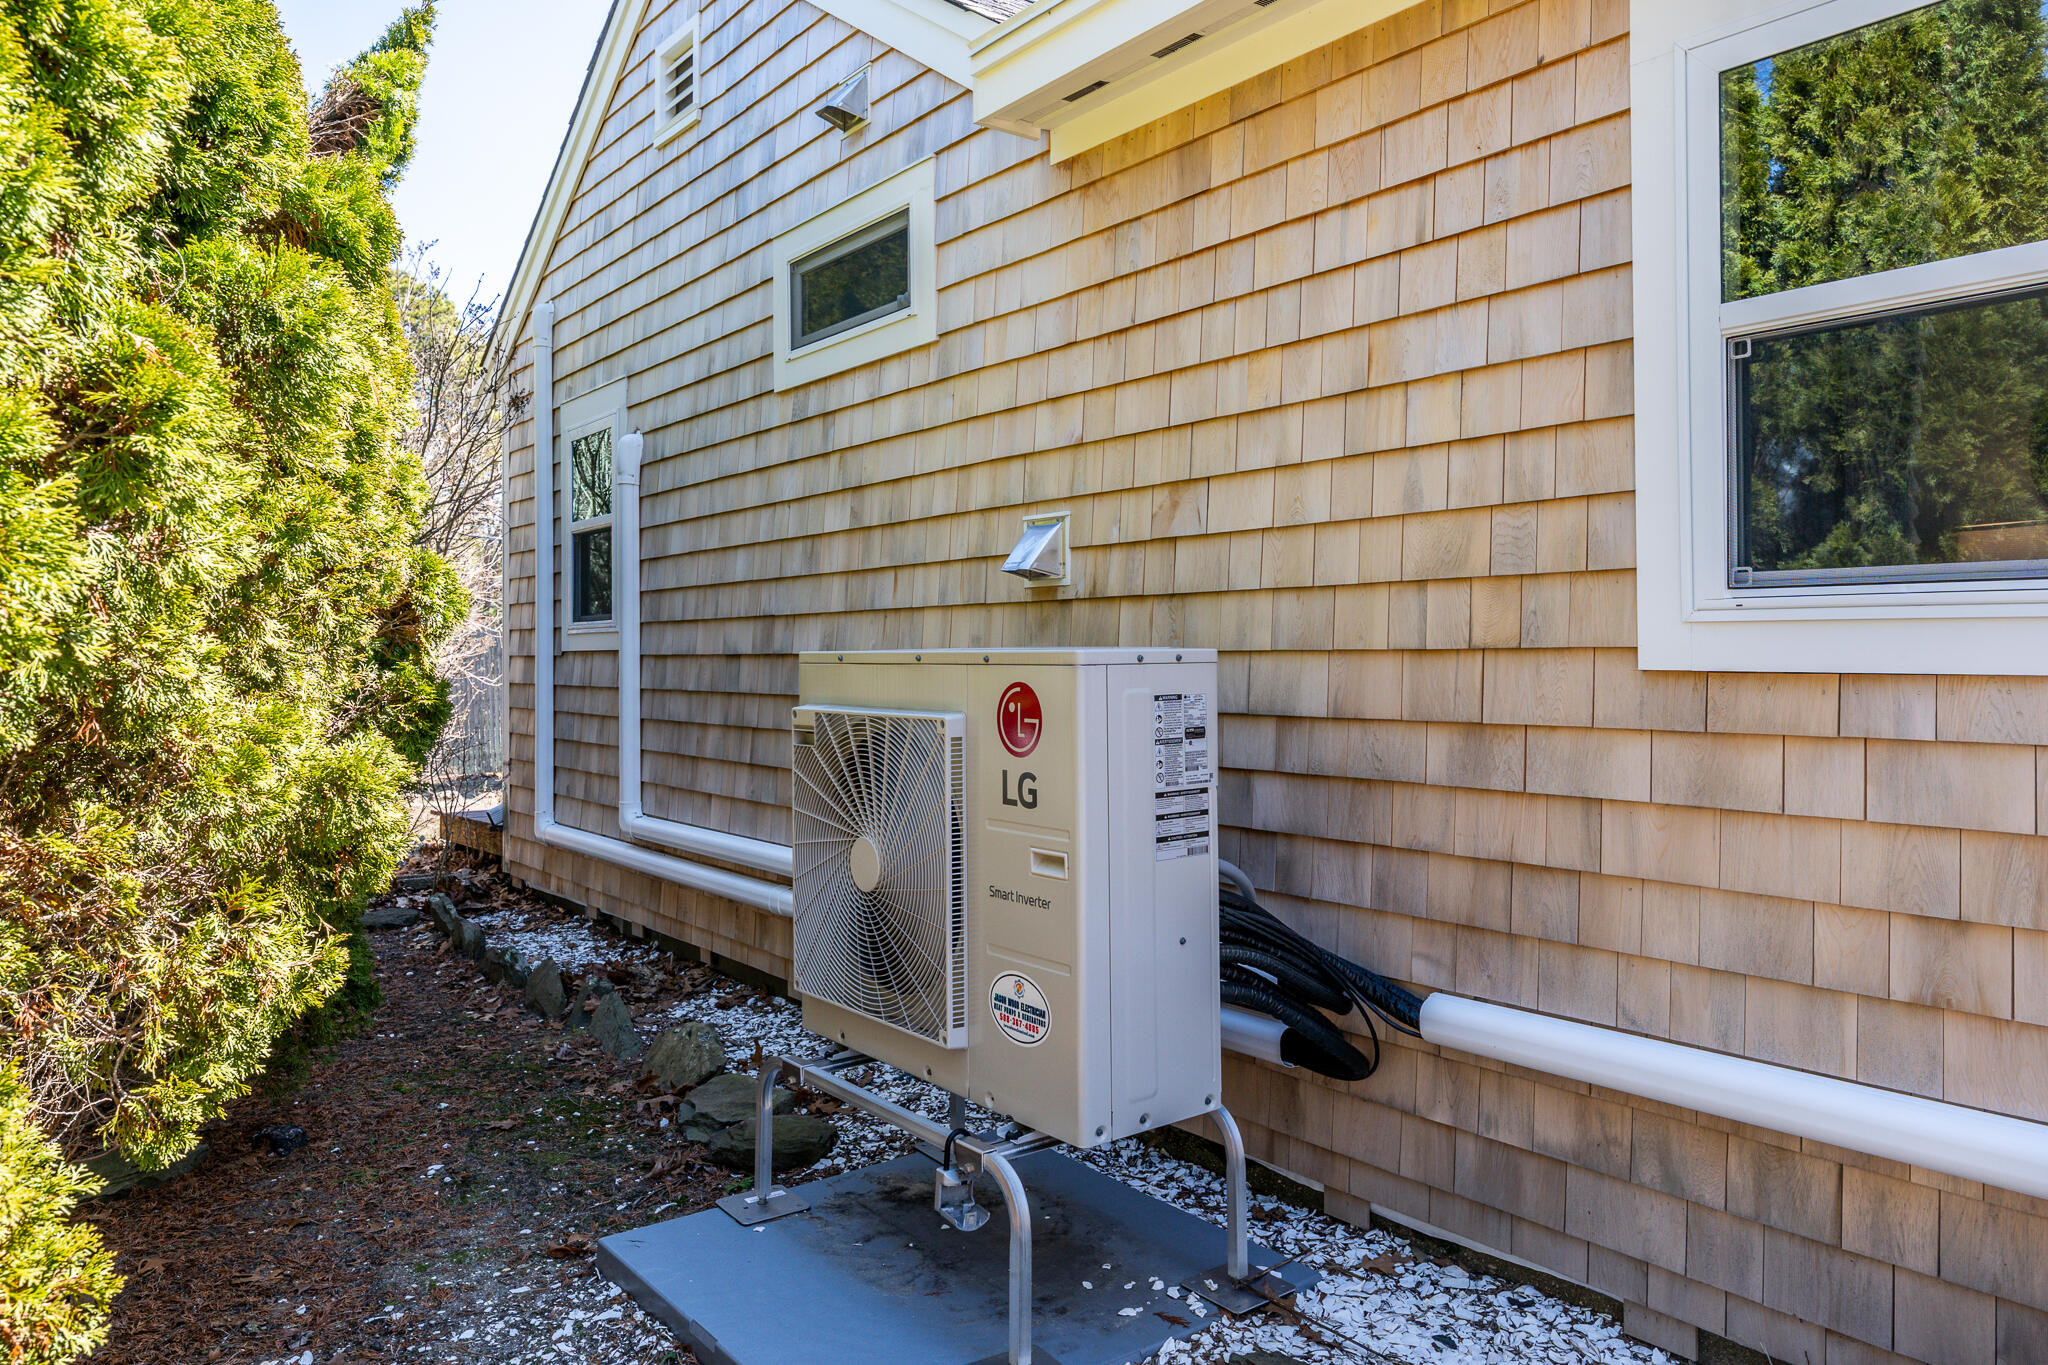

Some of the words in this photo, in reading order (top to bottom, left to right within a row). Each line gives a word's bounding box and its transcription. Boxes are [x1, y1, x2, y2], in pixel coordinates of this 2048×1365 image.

[1002, 769, 1038, 810] LG
[989, 885, 1015, 902] Smart
[1016, 890, 1051, 910] Inverter
[1020, 1002, 1046, 1020] ELECTRICIAN
